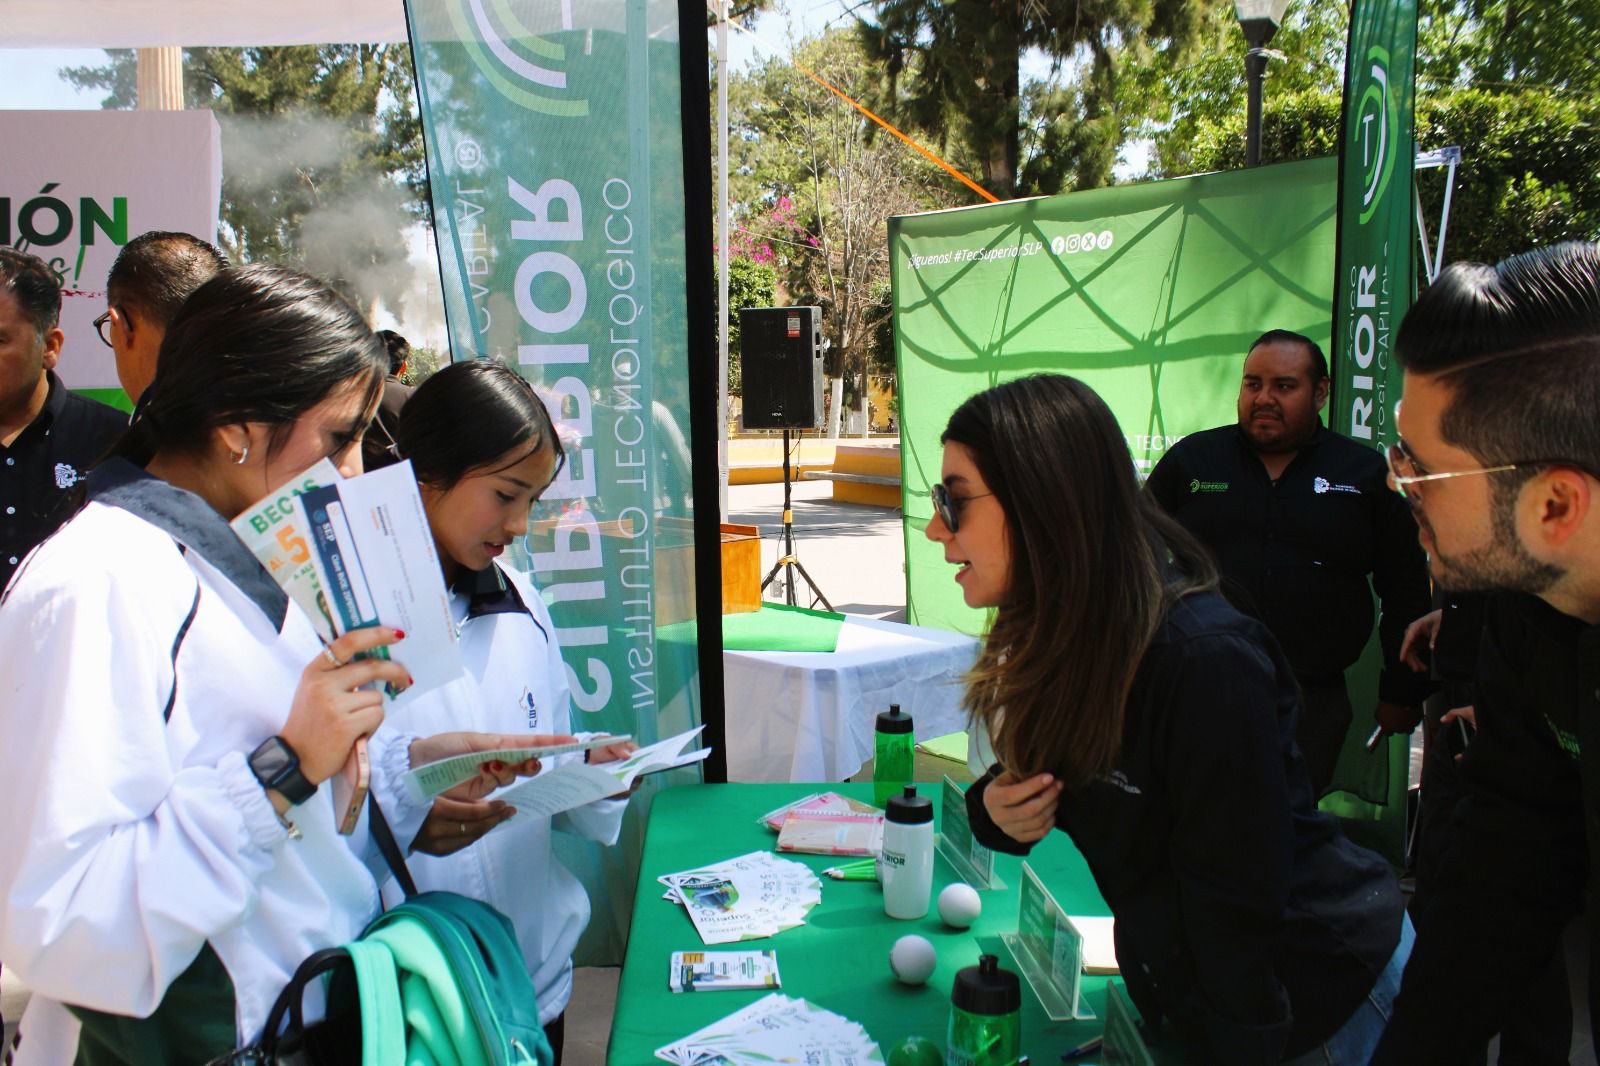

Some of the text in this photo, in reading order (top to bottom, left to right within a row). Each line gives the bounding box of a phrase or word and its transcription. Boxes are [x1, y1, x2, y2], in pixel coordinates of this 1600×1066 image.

[954, 241, 1043, 264] #TecSuperiorSLP
[1351, 264, 1377, 441] RIOR
[1135, 435, 1186, 450] TECN
[322, 522, 336, 542] SEP
